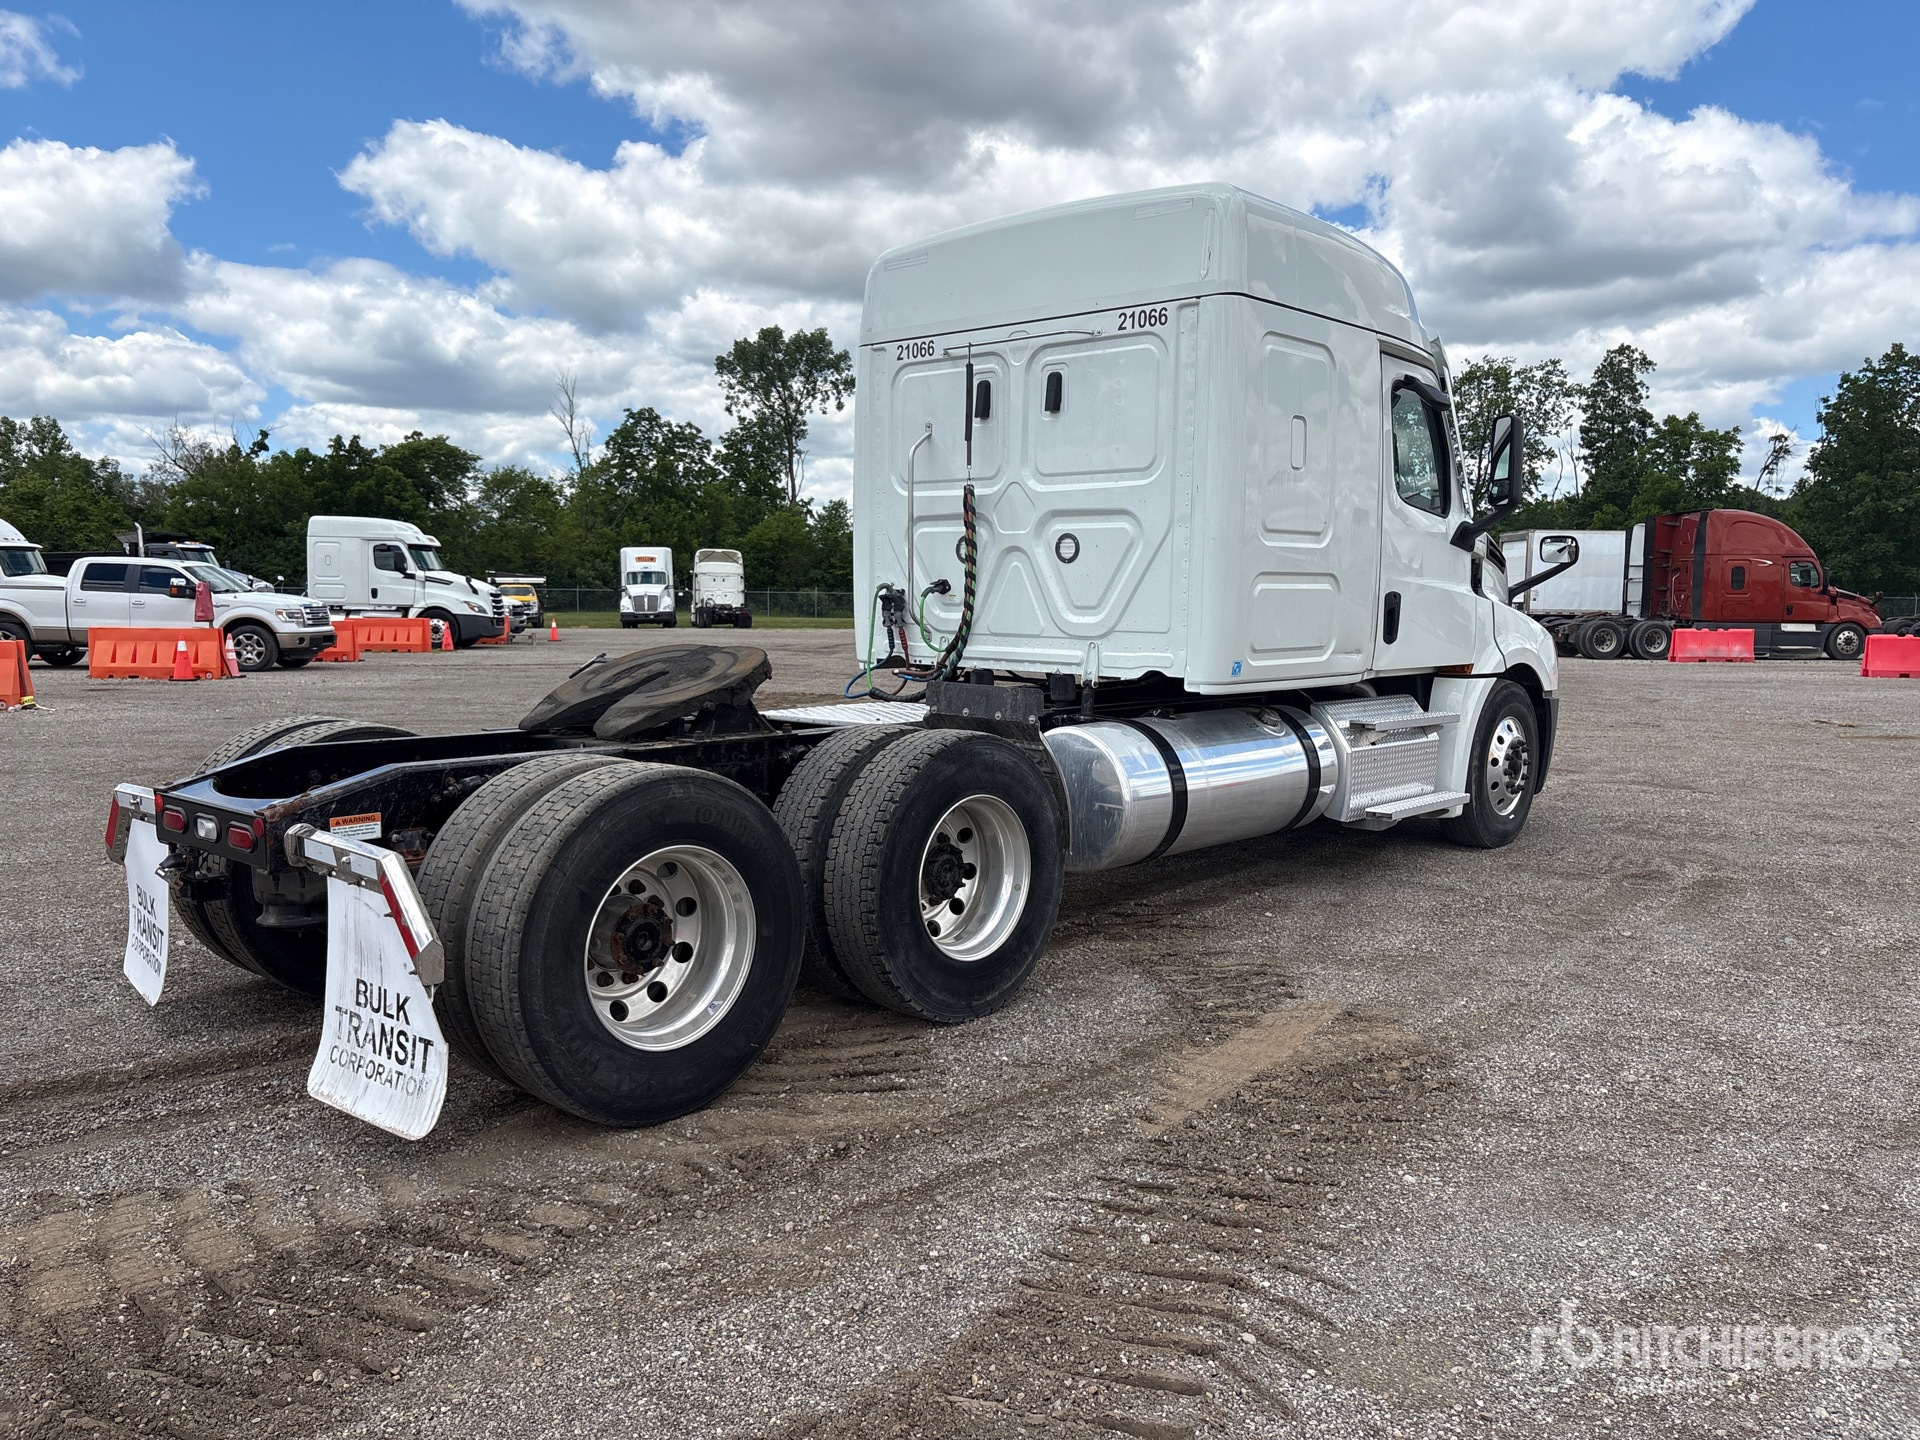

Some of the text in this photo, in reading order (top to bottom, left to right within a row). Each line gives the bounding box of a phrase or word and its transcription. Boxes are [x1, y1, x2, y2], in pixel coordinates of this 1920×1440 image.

[1117, 306, 1169, 331] 21066
[896, 340, 935, 361] 21066
[342, 815, 376, 824] WARNING
[136, 883, 157, 920] BULK
[132, 903, 164, 957] TRANSIT
[131, 933, 162, 977] CORPORATION
[355, 978, 411, 1026] BULK
[335, 1005, 434, 1074] TRANSIT
[330, 1045, 428, 1098] CORPORATION
